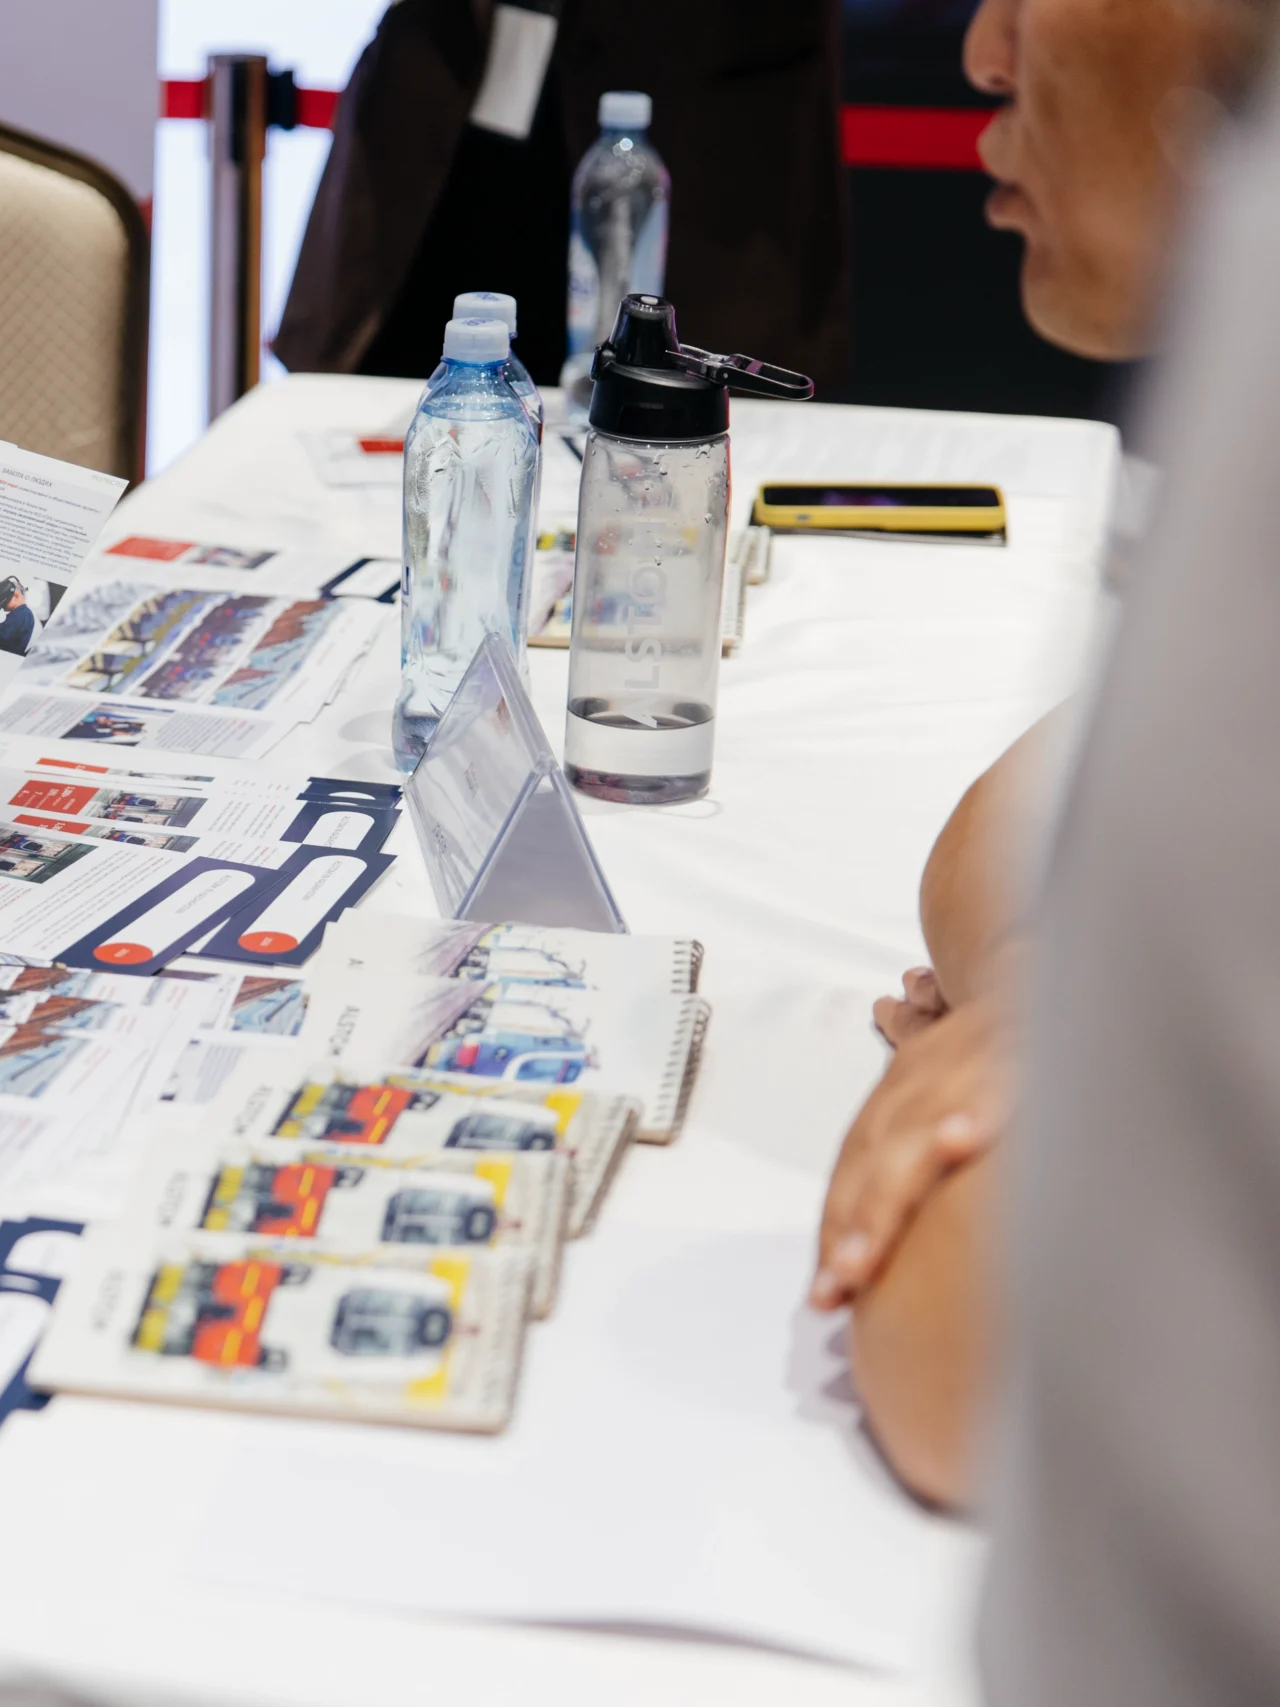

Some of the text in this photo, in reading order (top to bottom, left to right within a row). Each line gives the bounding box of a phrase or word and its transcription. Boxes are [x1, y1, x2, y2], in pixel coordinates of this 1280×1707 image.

[1, 467, 24, 479] ЗАБОТА
[30, 476, 53, 488] ЛЮДЯХ
[623, 521, 668, 729] ALSTOM
[329, 1004, 361, 1058] ALSTOM
